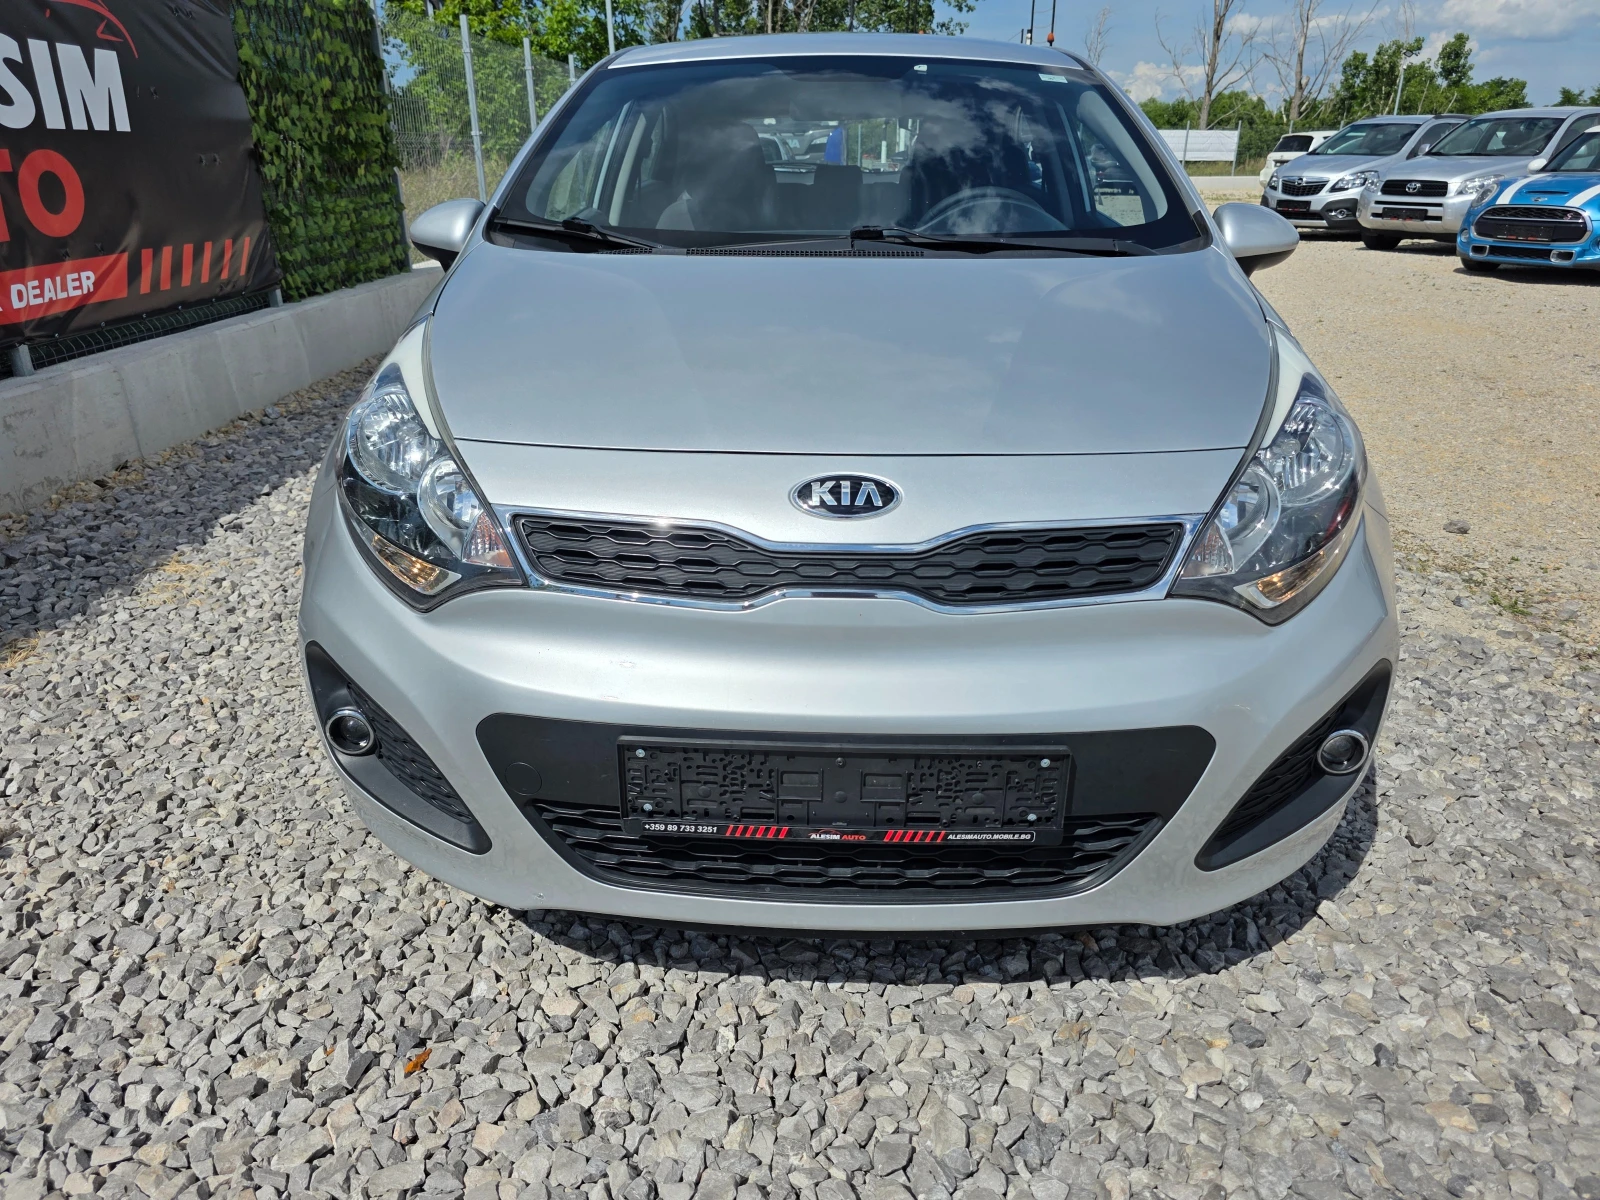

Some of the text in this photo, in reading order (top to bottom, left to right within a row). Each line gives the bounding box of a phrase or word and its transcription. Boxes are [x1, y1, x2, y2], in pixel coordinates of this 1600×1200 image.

[10, 270, 96, 310] DEALER
[811, 481, 883, 507] KIA
[644, 823, 665, 831] +359
[667, 824, 678, 832] 89
[680, 825, 696, 833] 733
